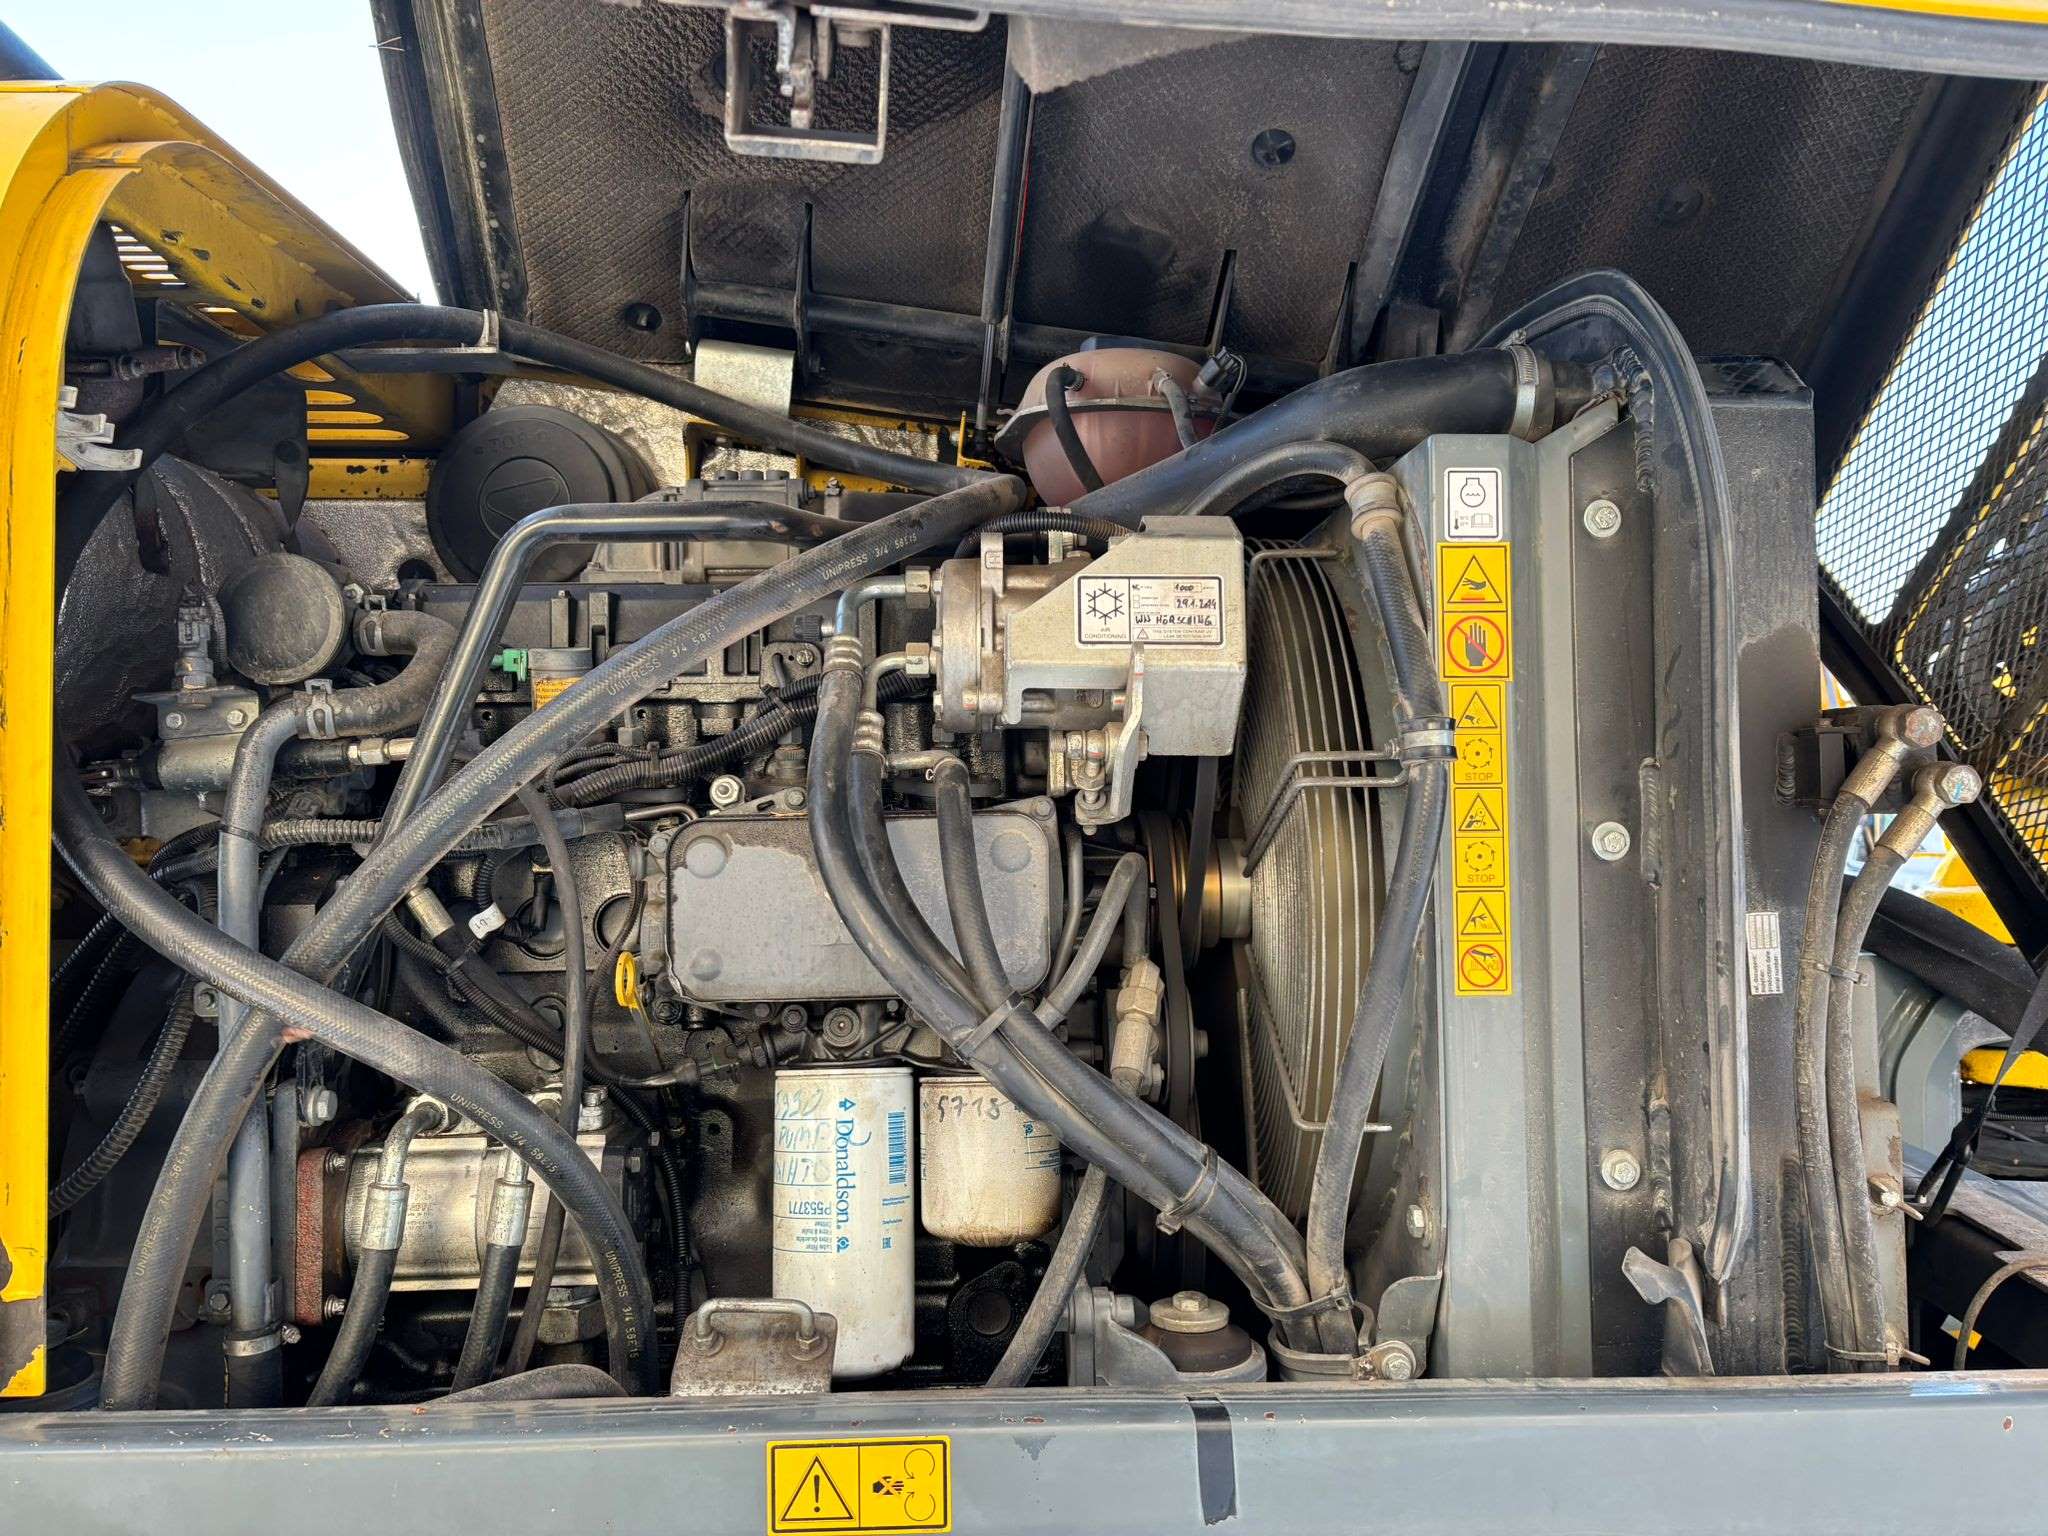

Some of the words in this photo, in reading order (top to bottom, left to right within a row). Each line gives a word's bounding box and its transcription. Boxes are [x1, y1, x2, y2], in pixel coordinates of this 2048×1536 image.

[822, 553, 868, 581] UNIPRESS
[874, 545, 889, 558] 3/4
[671, 643, 687, 658] 3/4
[1465, 772, 1494, 781] STOP
[1467, 874, 1496, 883] STOP
[450, 1092, 505, 1129] UNIPRESS
[508, 1130, 529, 1146] 3/4
[788, 1200, 833, 1215] P553771
[135, 1215, 162, 1277] UNIPRESS
[605, 1250, 629, 1298] UNIPRESS
